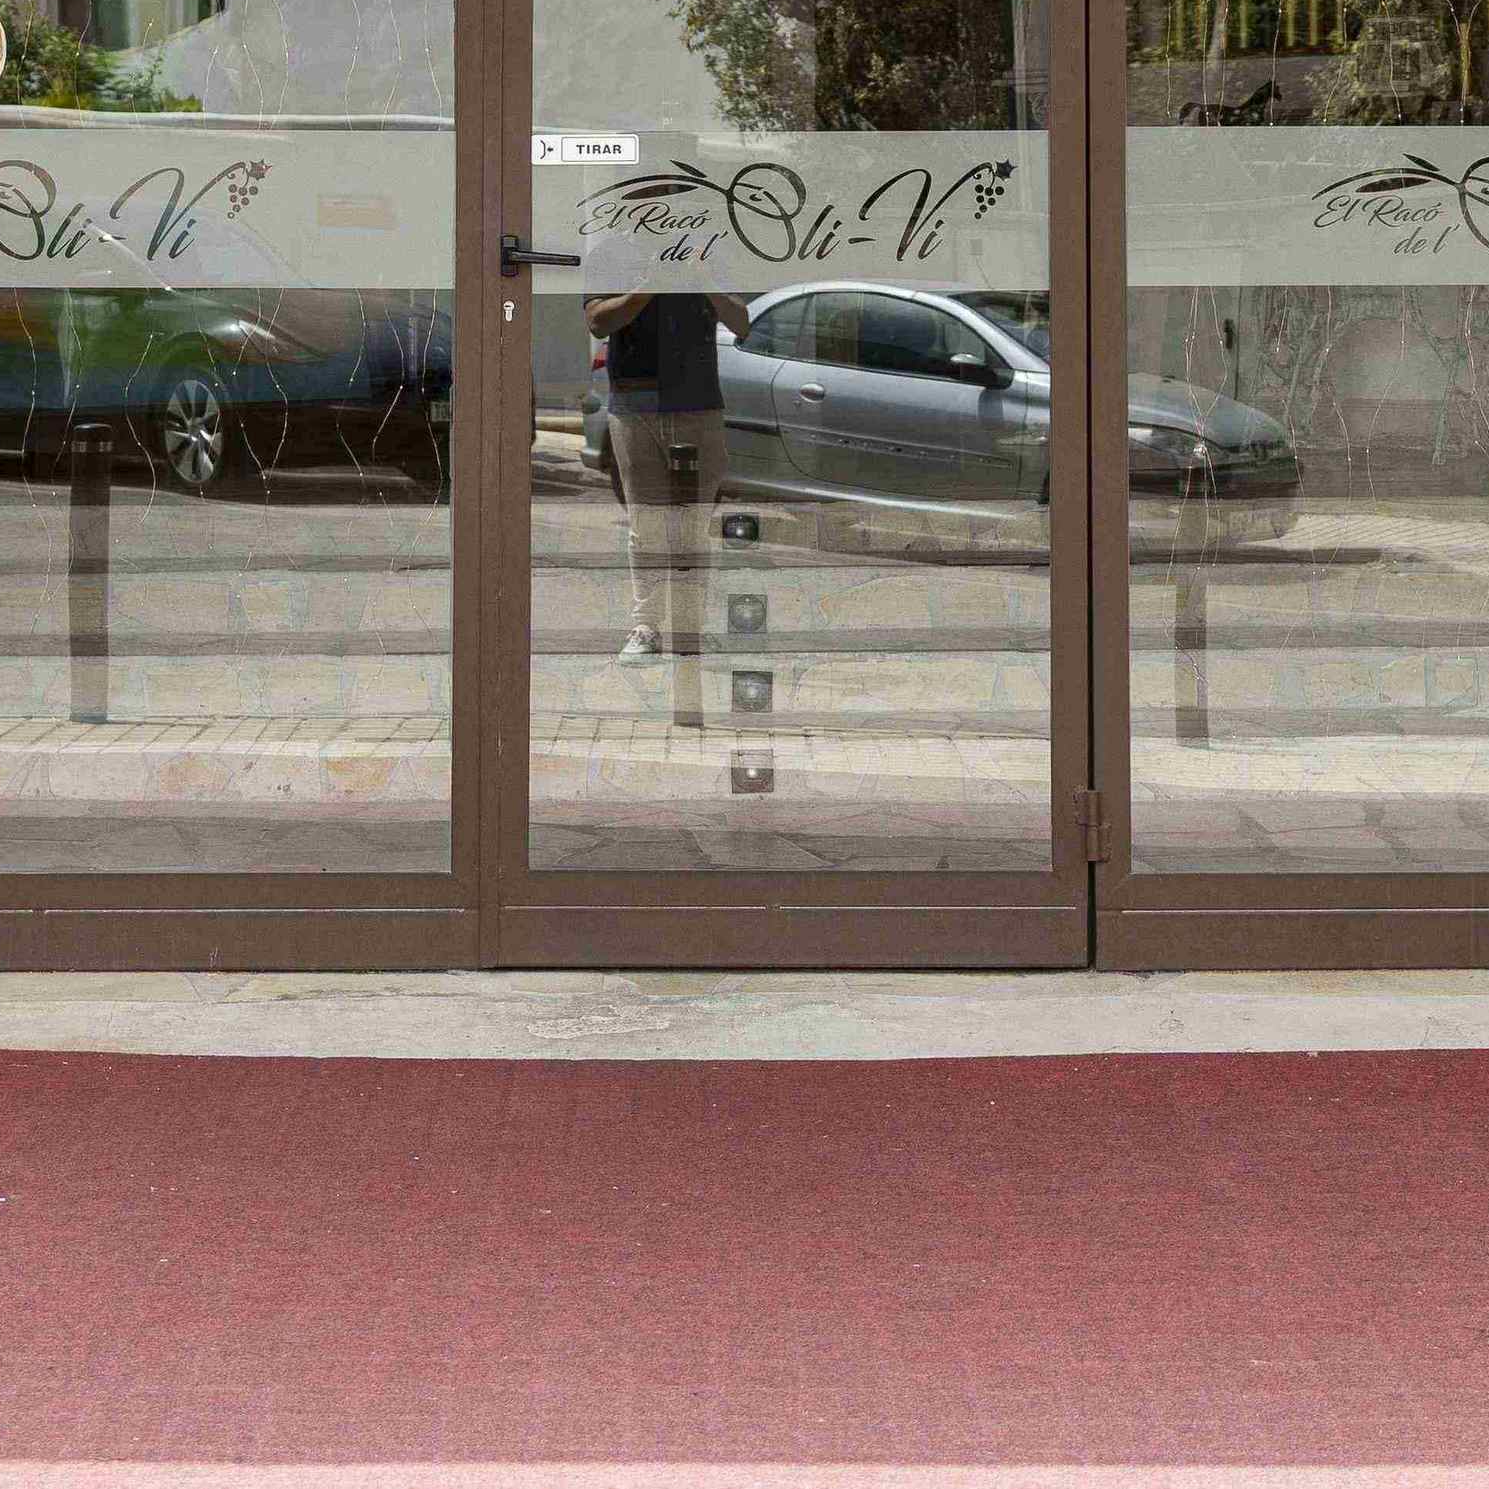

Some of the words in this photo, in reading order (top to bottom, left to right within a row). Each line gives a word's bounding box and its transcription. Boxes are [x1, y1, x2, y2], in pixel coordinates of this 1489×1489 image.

[576, 143, 622, 156] TIRAR
[579, 202, 624, 235] El
[627, 202, 712, 235] Racó
[1314, 195, 1363, 228] El
[1362, 195, 1442, 227] Racó
[660, 234, 698, 262] de
[1393, 227, 1428, 254] de
